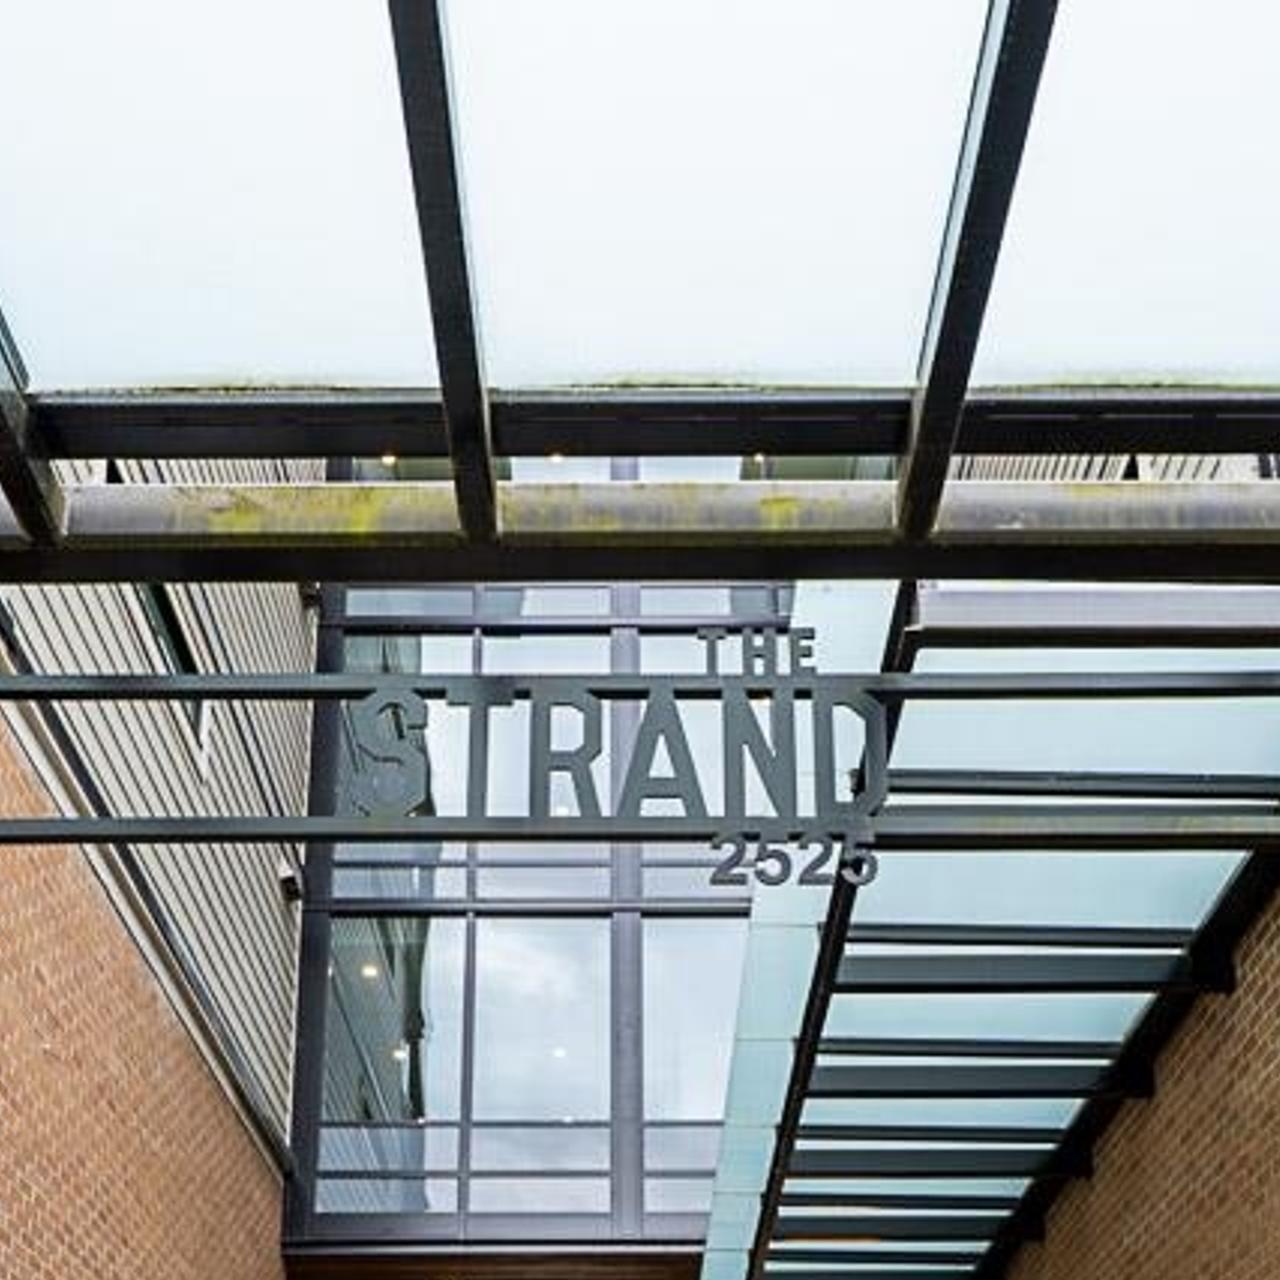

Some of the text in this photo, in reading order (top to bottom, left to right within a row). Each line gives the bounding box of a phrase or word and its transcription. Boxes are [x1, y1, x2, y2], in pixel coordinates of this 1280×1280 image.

[698, 627, 817, 676] THE
[348, 686, 890, 824] STRAND
[709, 836, 879, 887] 2525
